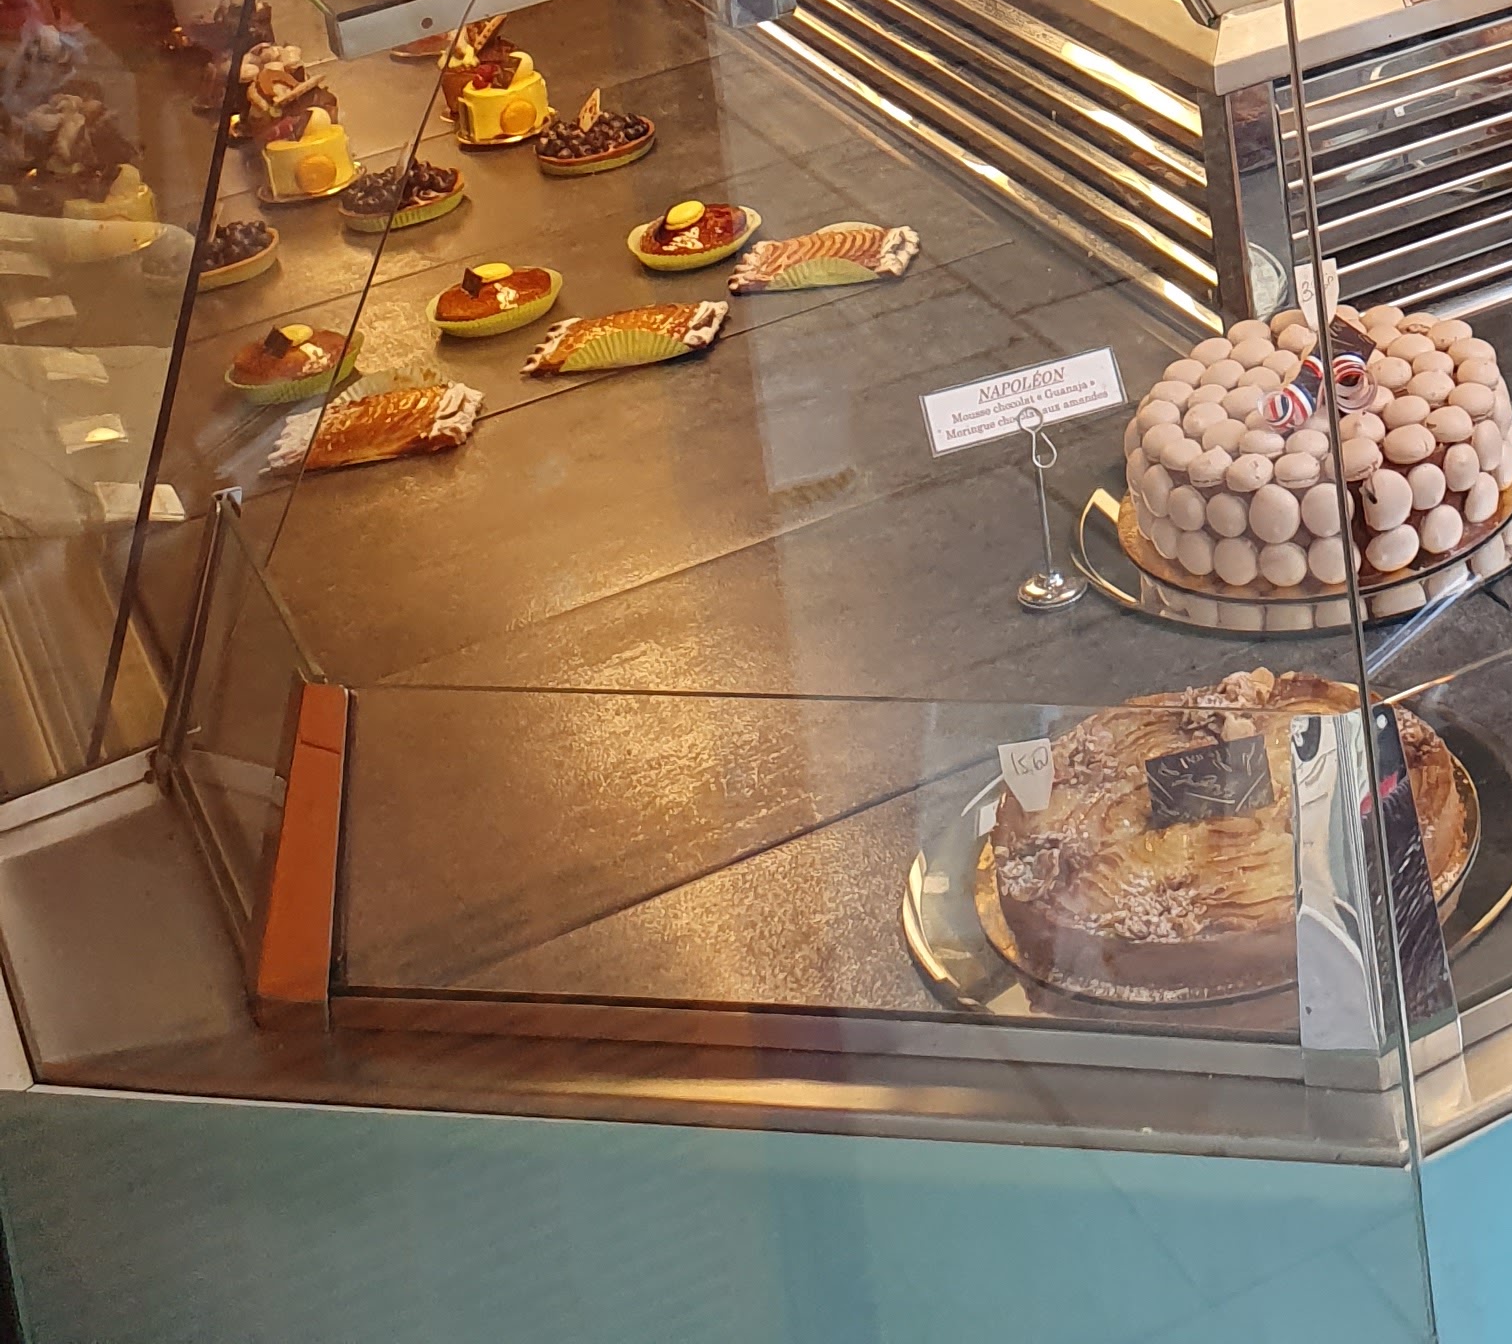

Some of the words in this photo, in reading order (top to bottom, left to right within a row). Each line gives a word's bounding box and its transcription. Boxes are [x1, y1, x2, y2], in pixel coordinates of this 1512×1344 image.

[952, 406, 992, 424] Mousse
[993, 395, 1036, 414] chocolat
[1044, 380, 1089, 400] Guanaja
[978, 366, 1066, 404] NAPOLÉON
[946, 420, 996, 441] Meringue
[1041, 403, 1062, 415] aux
[1063, 389, 1110, 409] amandes
